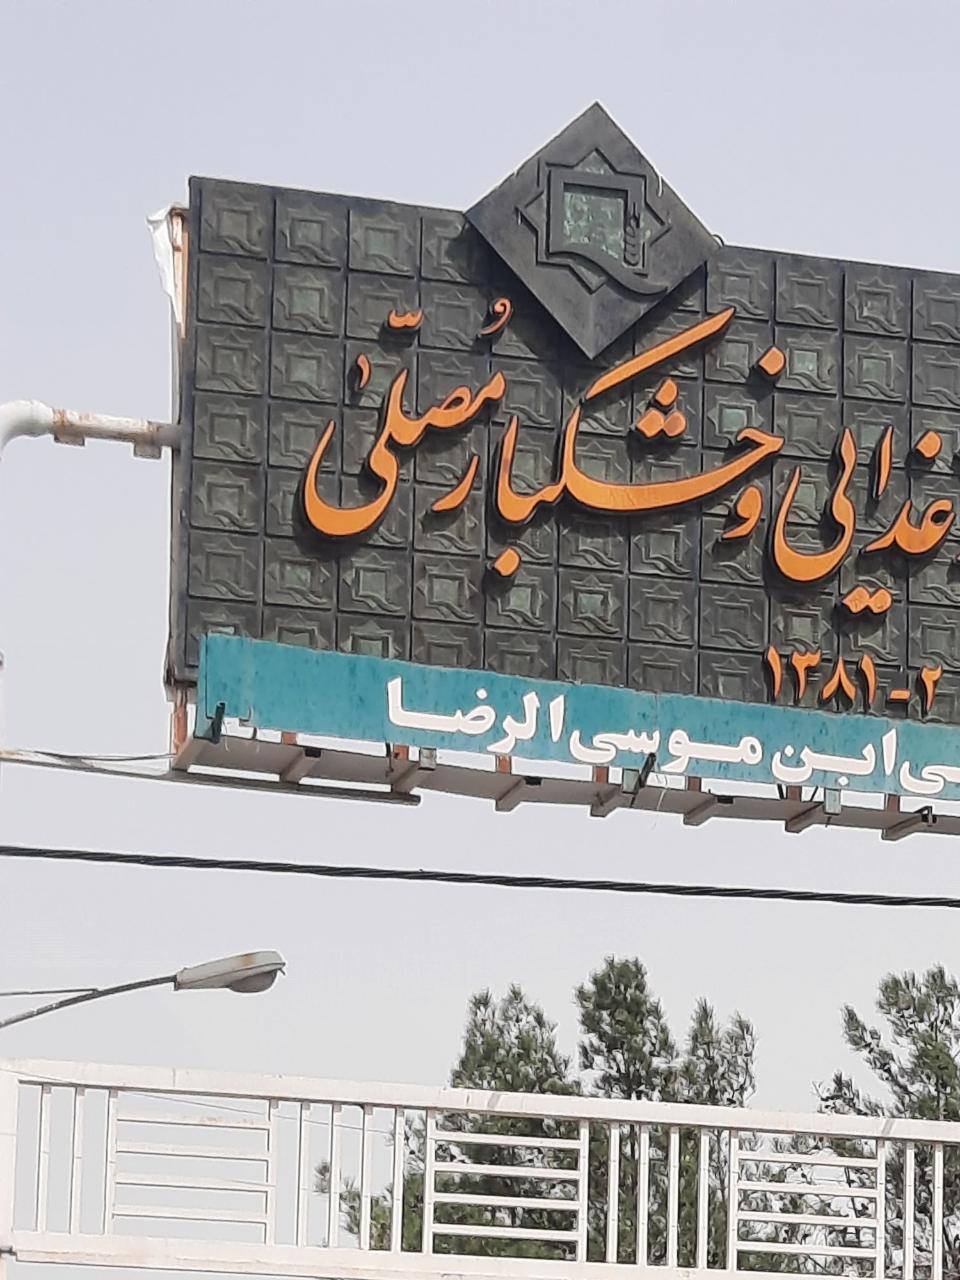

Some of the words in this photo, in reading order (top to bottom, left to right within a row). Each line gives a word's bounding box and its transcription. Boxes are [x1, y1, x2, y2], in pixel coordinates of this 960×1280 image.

[435, 311, 785, 576] خشکبار
[728, 486, 764, 539] و
[387, 676, 566, 759] الرضا
[569, 729, 764, 774] موسی
[771, 727, 898, 787] ابن
